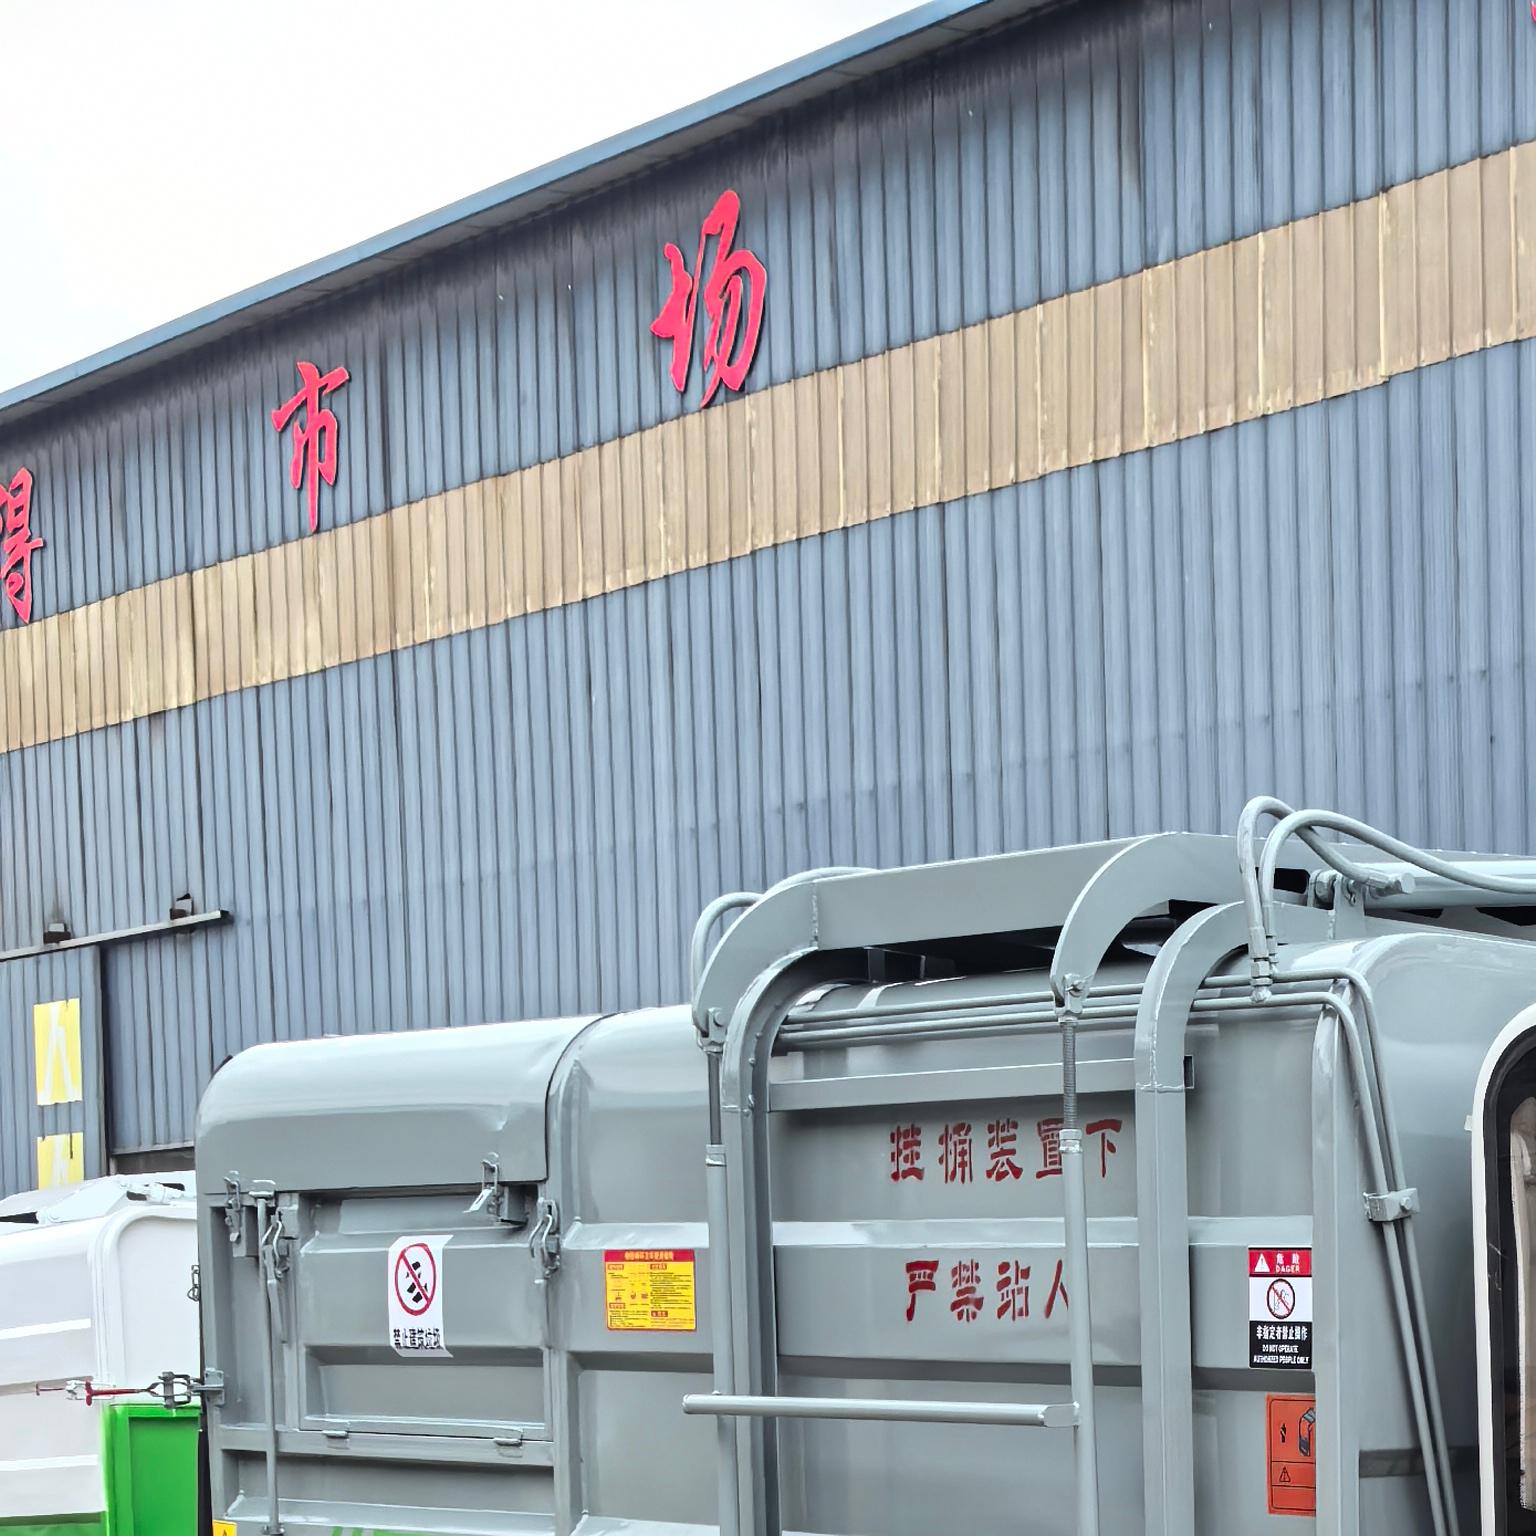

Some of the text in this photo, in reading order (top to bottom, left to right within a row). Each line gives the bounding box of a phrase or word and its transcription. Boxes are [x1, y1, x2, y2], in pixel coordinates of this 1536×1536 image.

[271, 361, 350, 533] 市
[650, 188, 768, 409] 场
[905, 1258, 1069, 1323] 严禁站人
